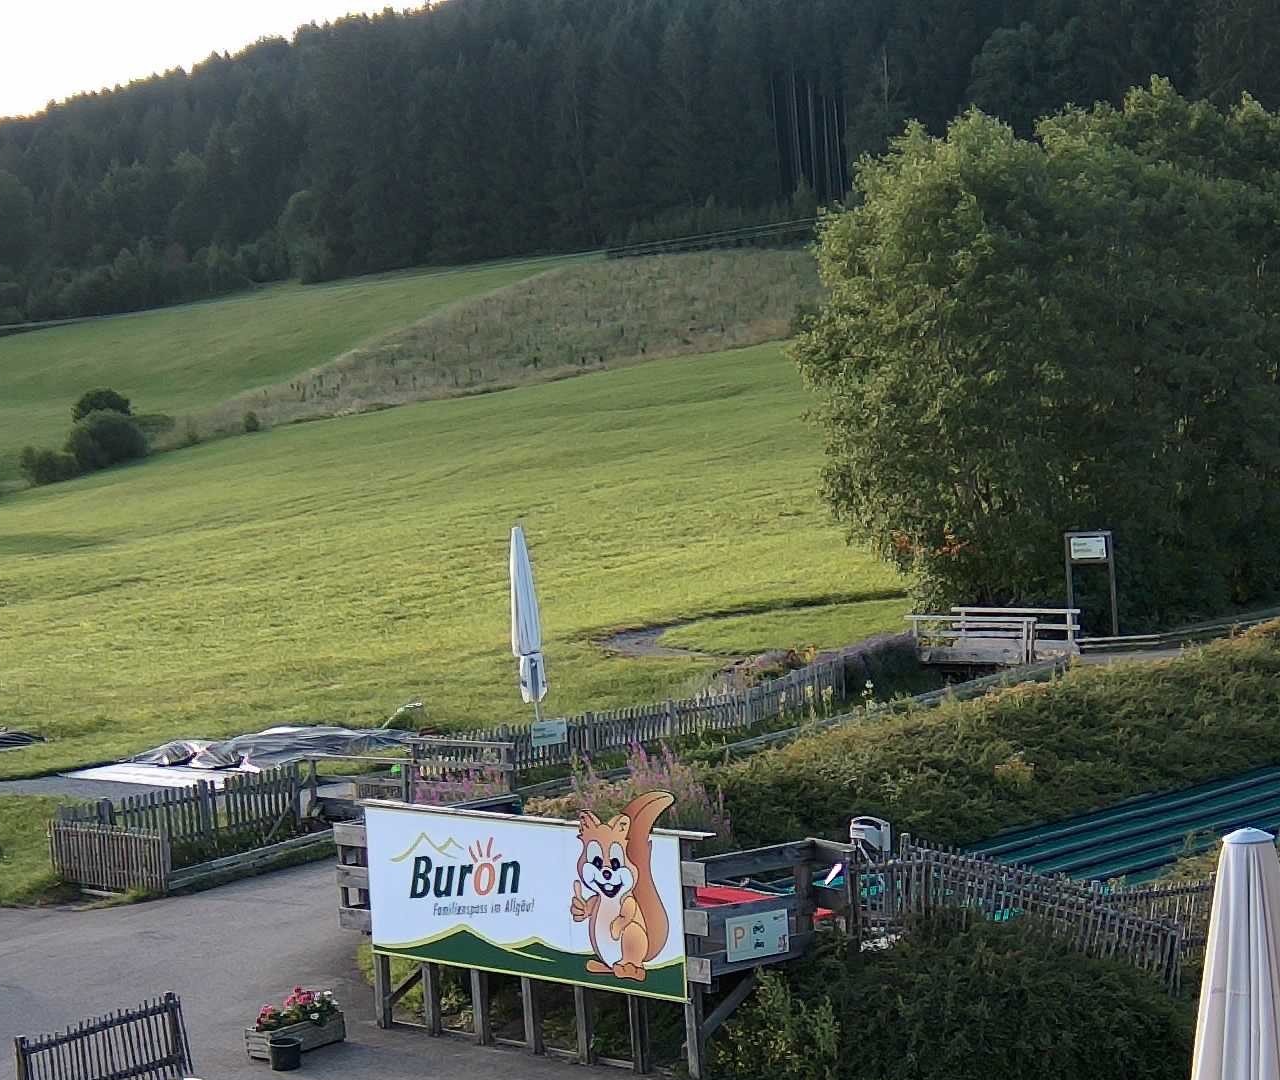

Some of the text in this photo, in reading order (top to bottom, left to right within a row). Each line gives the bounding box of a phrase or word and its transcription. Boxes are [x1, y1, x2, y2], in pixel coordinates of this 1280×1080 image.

[409, 855, 521, 899] Buron
[490, 902, 502, 914] im
[733, 926, 746, 949] P
